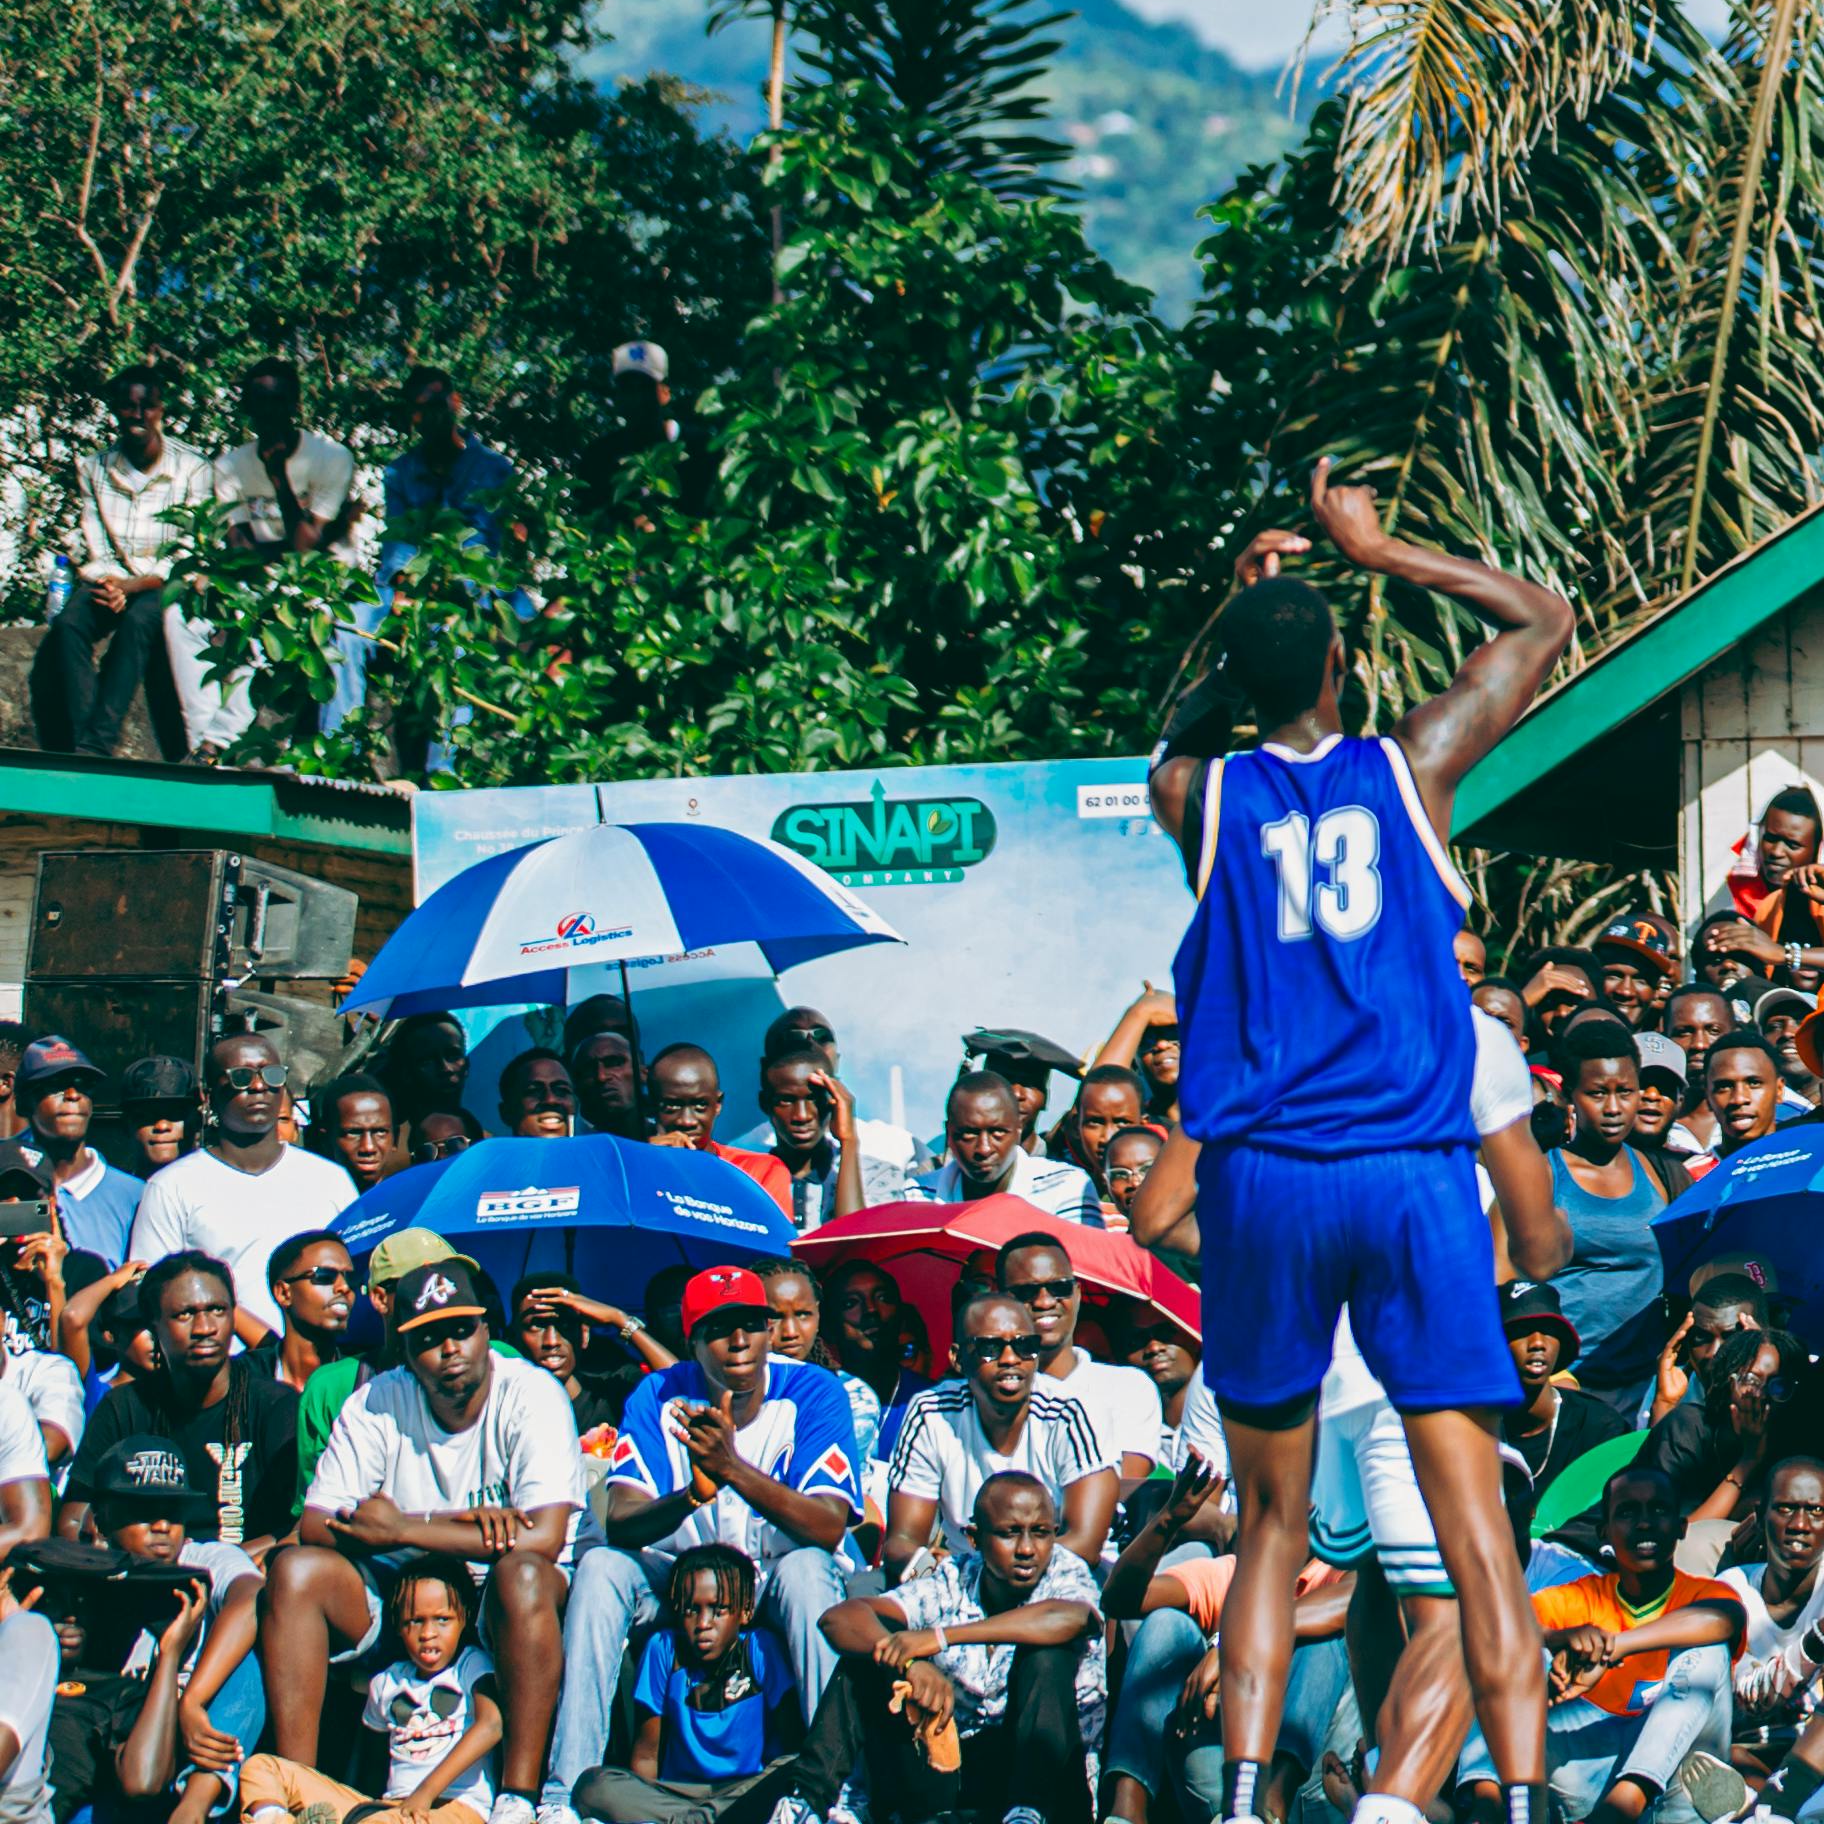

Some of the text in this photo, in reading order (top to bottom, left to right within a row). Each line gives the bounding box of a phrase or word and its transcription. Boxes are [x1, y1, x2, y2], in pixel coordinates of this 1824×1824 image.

[785, 796, 984, 867] SINAPI
[842, 870, 953, 886] OMPANY
[1260, 803, 1384, 944] 13
[520, 929, 633, 956] Access Logistics
[487, 1196, 575, 1212] BGF
[684, 1195, 734, 1216] Banque
